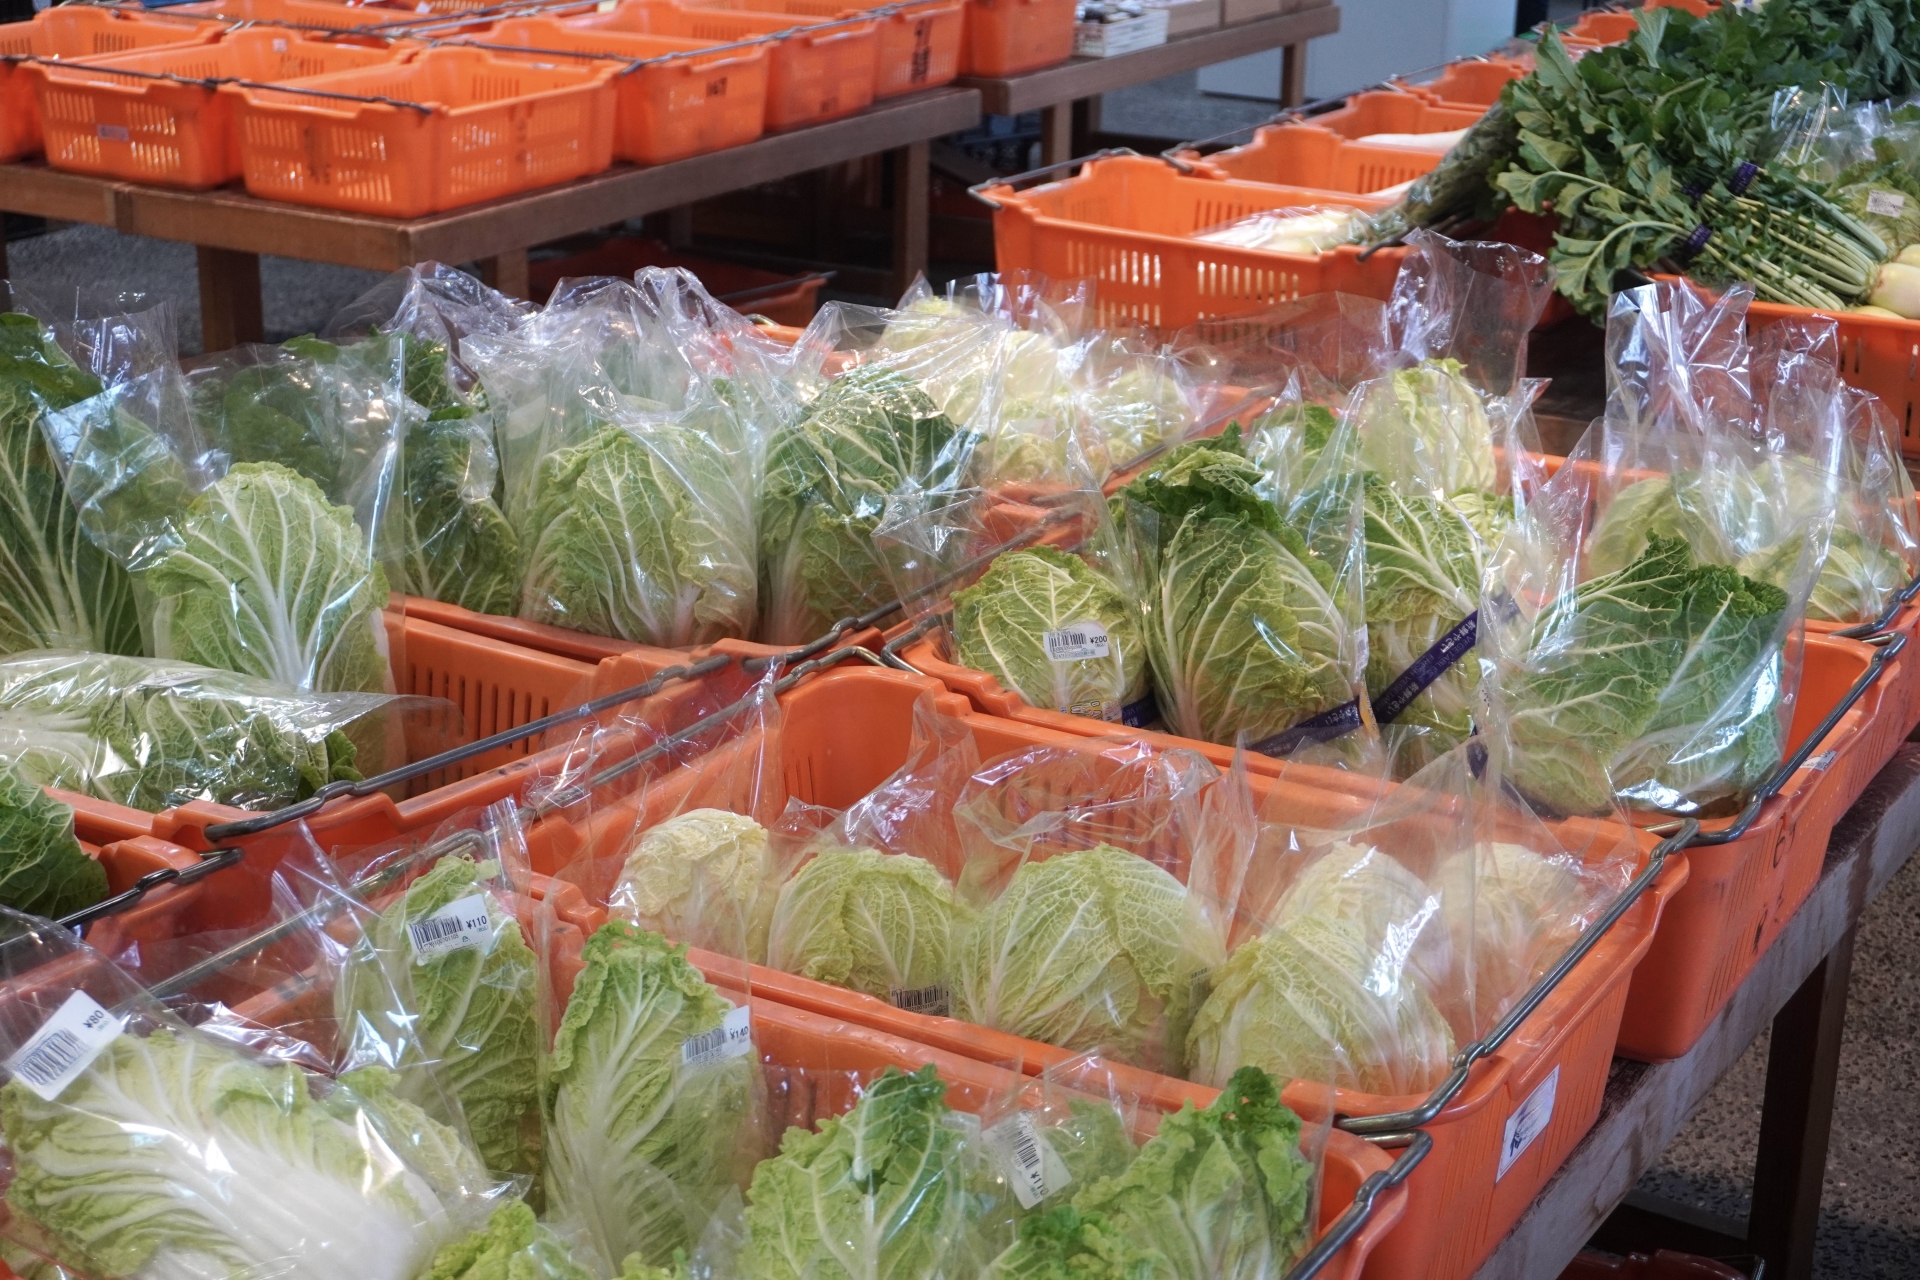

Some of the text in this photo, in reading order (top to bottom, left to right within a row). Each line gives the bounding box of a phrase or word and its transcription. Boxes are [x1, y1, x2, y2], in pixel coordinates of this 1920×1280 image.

[1089, 634, 1108, 645] ¥200
[466, 915, 488, 930] ¥110
[82, 1009, 105, 1029] ¥80
[1030, 1170, 1050, 1196] ¥110
